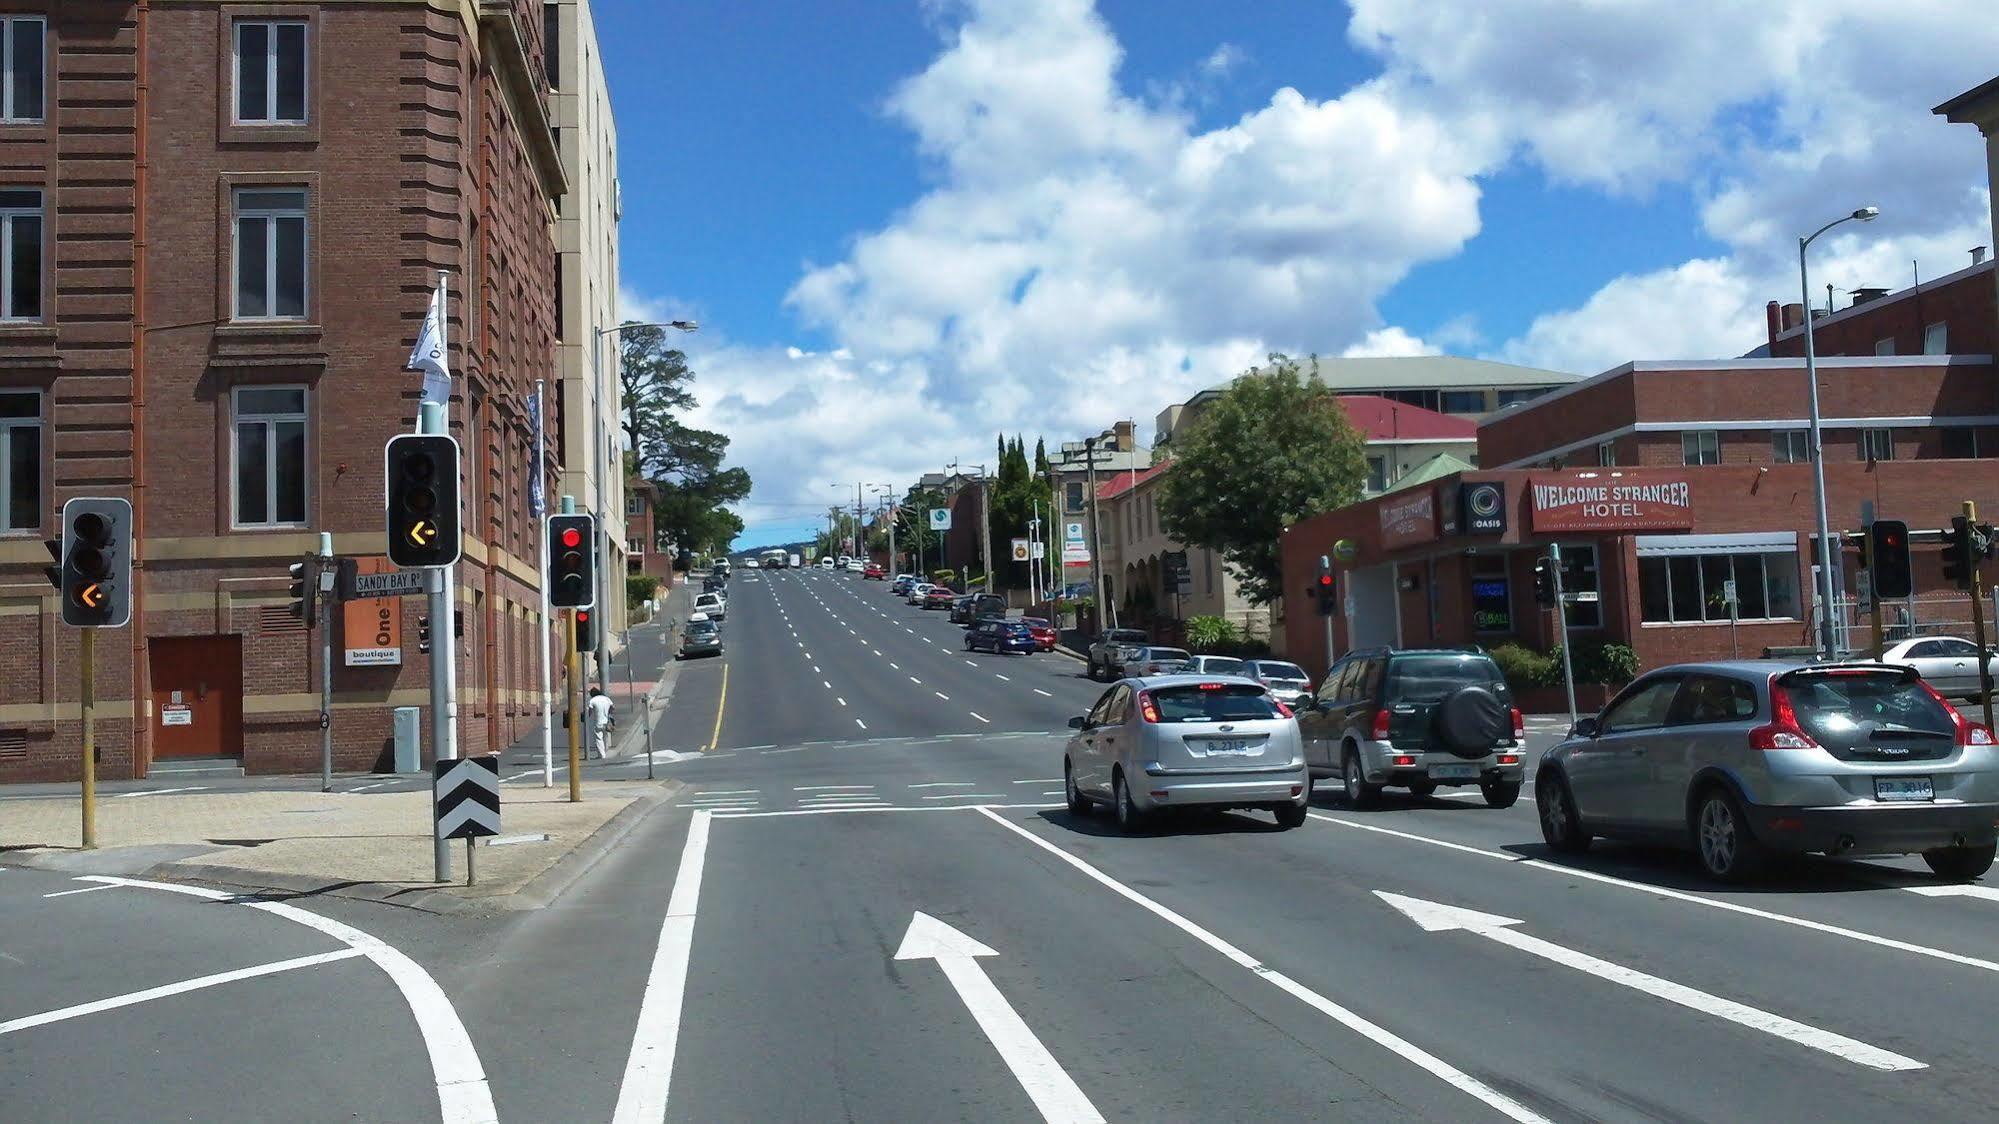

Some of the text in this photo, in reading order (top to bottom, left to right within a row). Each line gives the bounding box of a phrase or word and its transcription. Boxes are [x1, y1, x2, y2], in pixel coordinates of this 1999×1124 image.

[1534, 482, 1689, 511] WELCOME STRANGER
[1583, 503, 1644, 517] HOTEL
[1476, 519, 1501, 528] OASIS
[358, 575, 388, 591] SANDY
[390, 573, 407, 588] BAY
[352, 650, 395, 659] boutique
